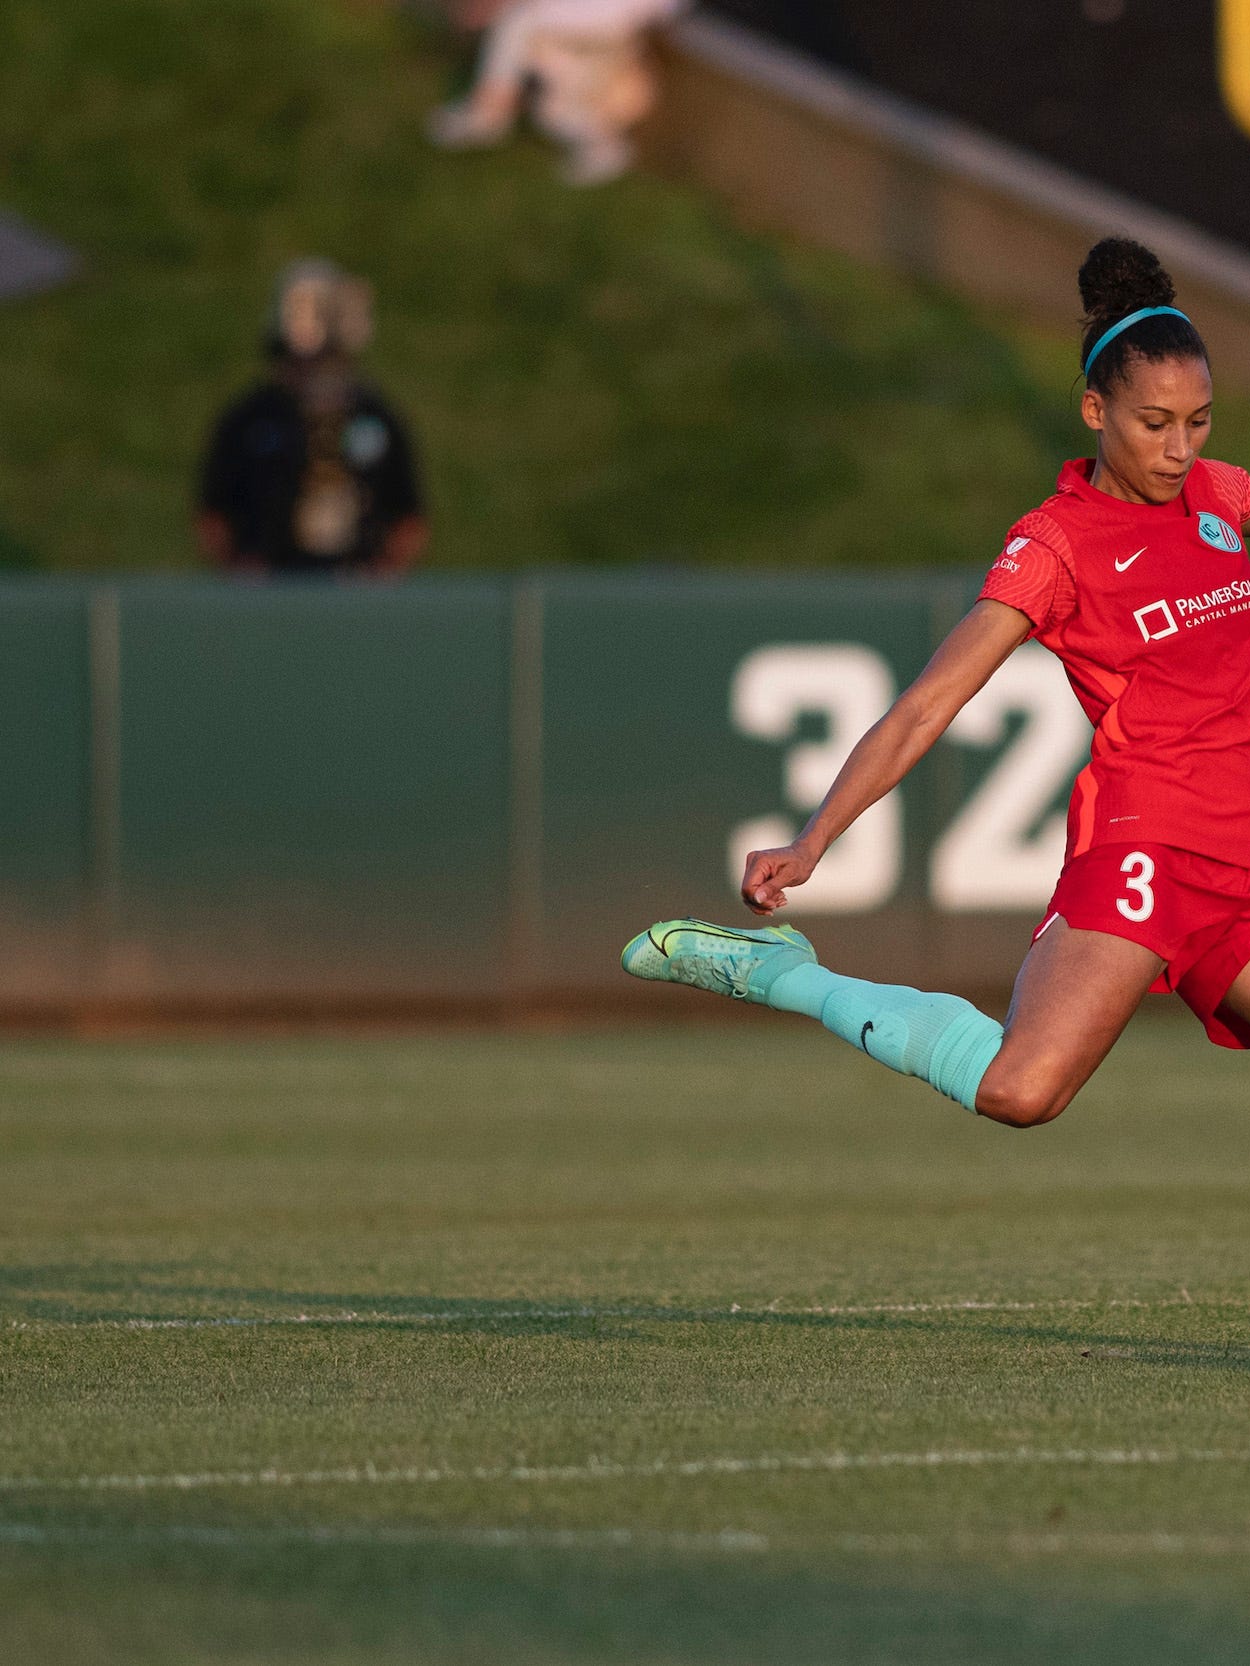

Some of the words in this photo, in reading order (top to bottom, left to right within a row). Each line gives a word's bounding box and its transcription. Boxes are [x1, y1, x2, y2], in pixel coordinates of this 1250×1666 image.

[1200, 523, 1220, 541] KC
[1185, 608, 1227, 629] CAPITAL
[1115, 851, 1155, 923] 3
